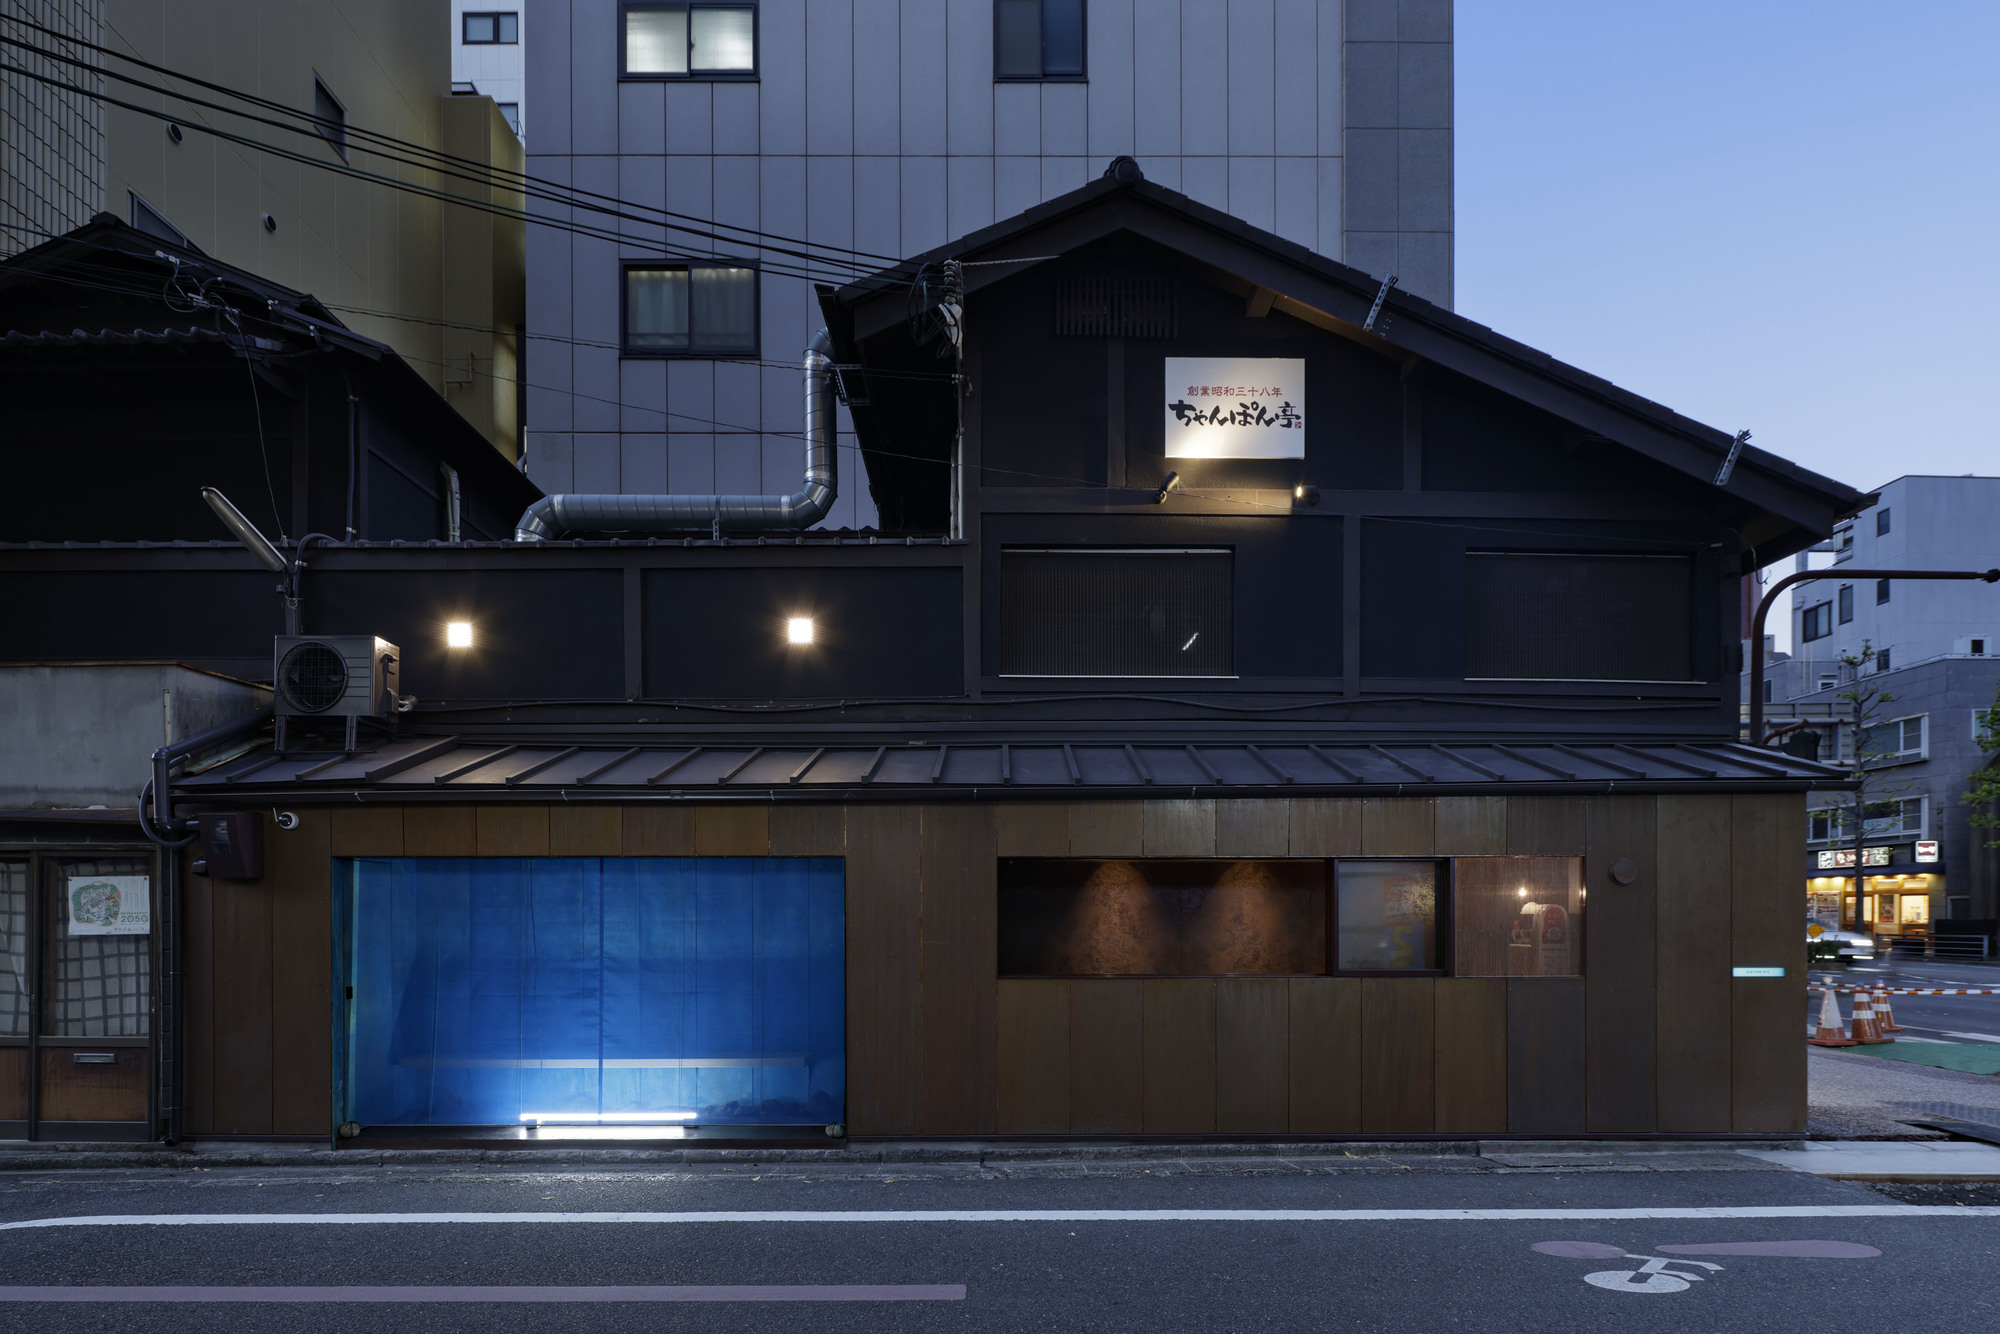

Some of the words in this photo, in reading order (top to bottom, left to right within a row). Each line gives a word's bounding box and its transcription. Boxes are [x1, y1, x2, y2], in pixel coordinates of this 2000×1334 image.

[1187, 385, 1283, 398] 創業昭和三十八年
[1168, 399, 1302, 428] ちゃんぽん亭
